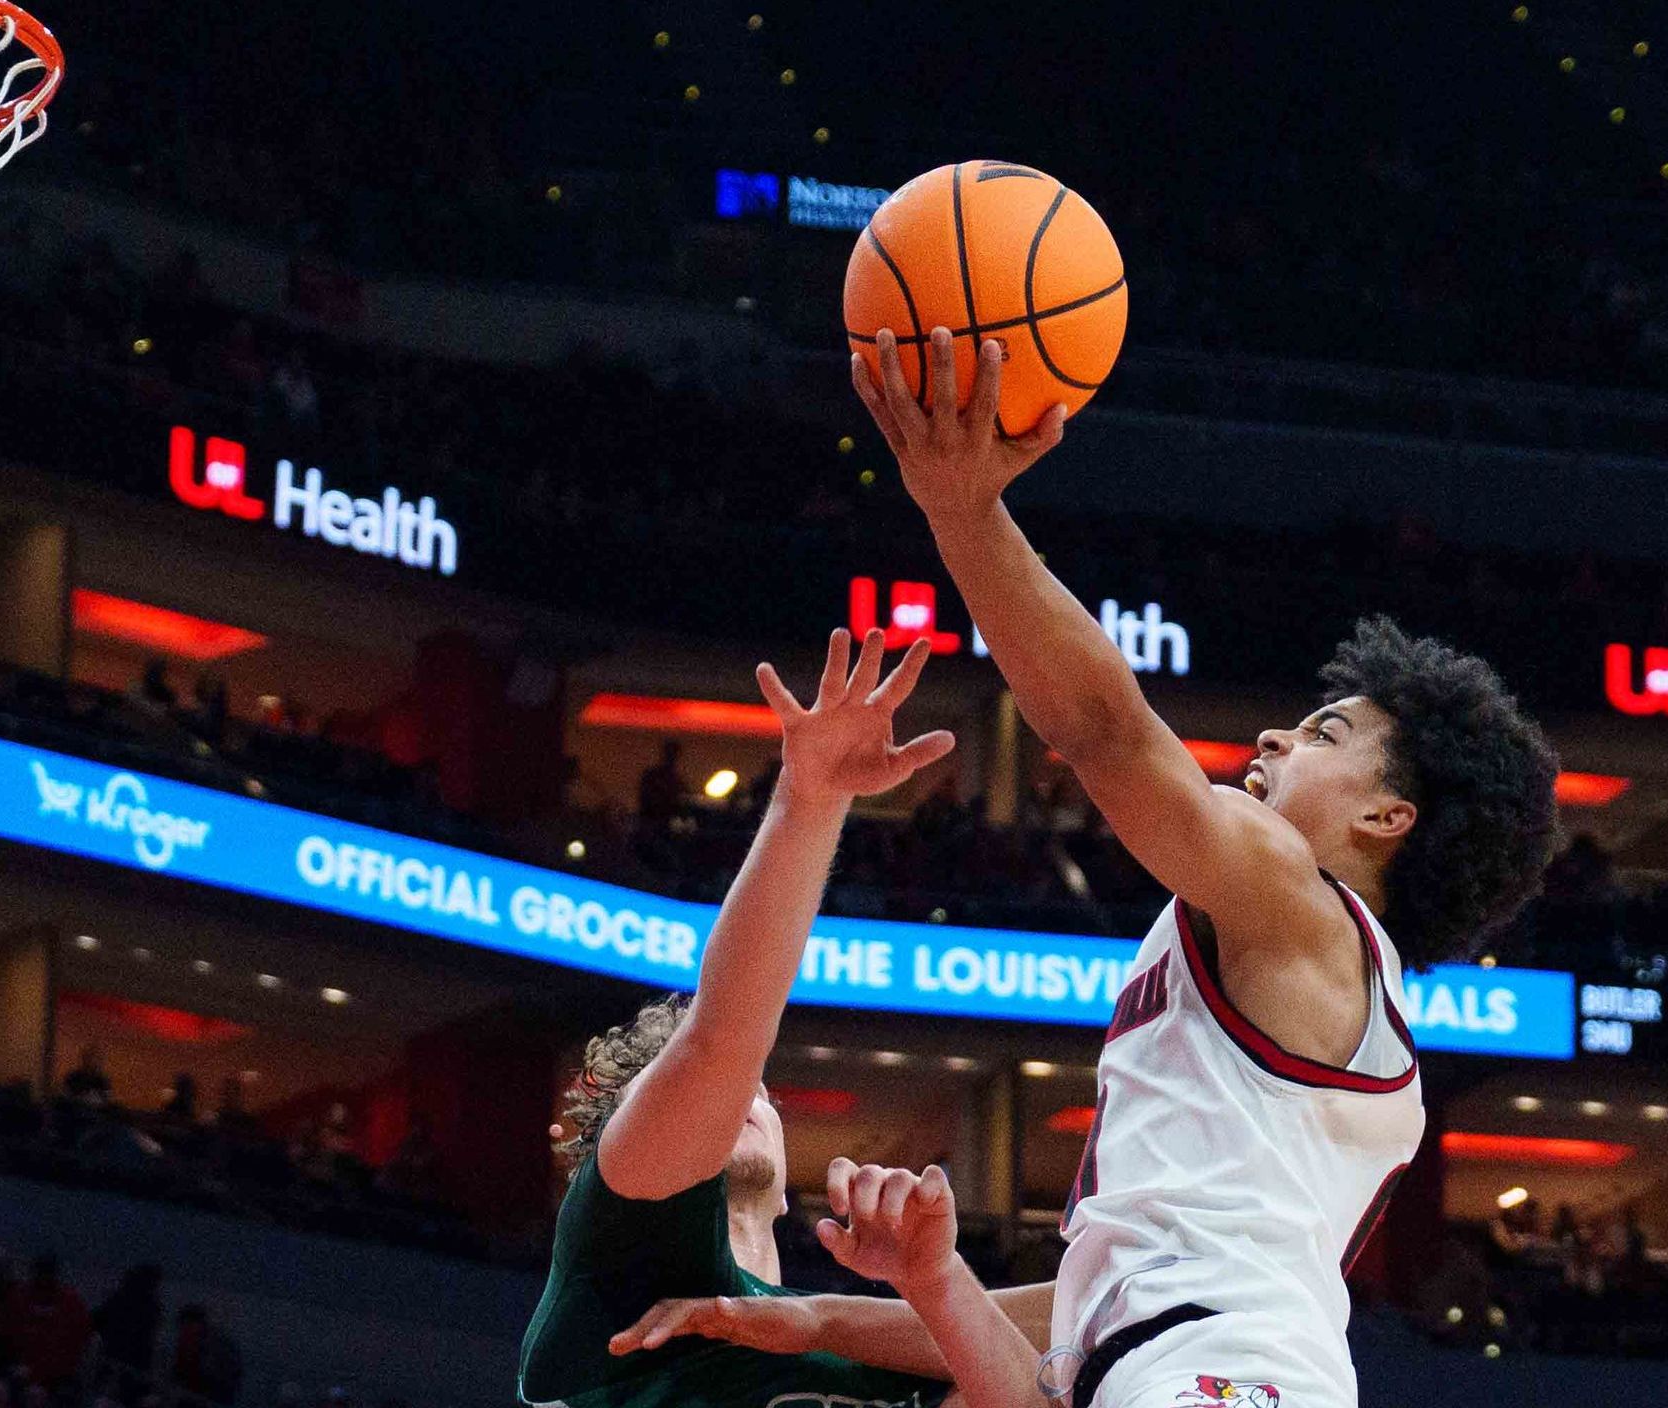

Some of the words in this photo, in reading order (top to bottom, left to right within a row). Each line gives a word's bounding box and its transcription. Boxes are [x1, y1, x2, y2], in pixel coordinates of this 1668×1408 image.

[274, 458, 457, 576] Health
[87, 773, 211, 868] Kroger
[295, 834, 501, 925] OFFICIAL
[509, 886, 698, 969] GROCER
[800, 936, 893, 989] THE
[913, 943, 1135, 1003] LOUISVI
